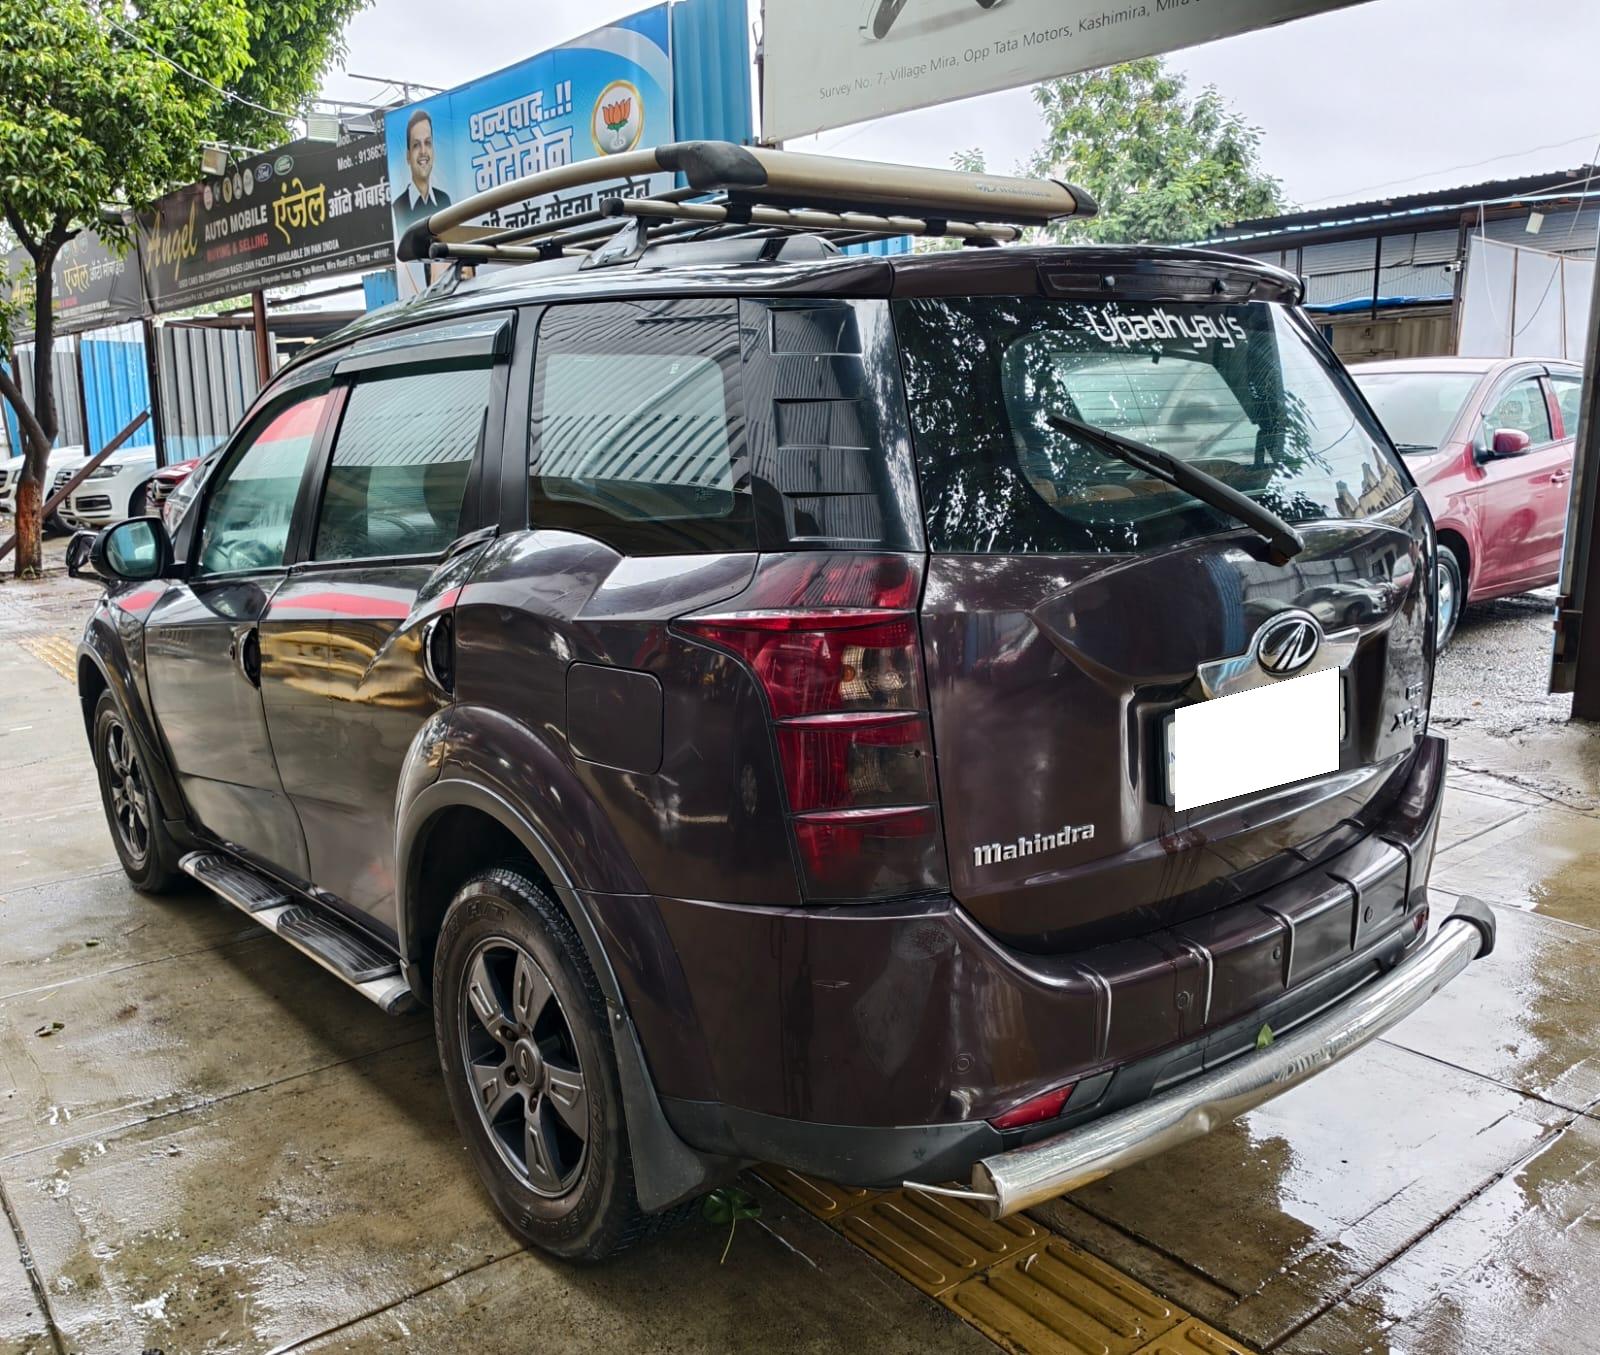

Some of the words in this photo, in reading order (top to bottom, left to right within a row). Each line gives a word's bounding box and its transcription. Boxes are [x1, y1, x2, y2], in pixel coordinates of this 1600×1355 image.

[819, 82, 851, 99] Survey
[854, 77, 872, 90] No.
[889, 62, 927, 80] Village
[930, 55, 960, 72] Mira,
[963, 47, 990, 64] Opp
[994, 38, 1018, 54] Tata
[1023, 25, 1073, 48] Motors,
[1078, 6, 1150, 33] Kashimira,
[204, 217, 229, 242] AUTO
[230, 204, 268, 233] MOBILE
[272, 177, 326, 245] एंजेल
[328, 188, 352, 218] ऑटो
[146, 199, 198, 281] Angel
[239, 233, 269, 253] SELLING
[1084, 306, 1247, 348] Upadhyay's
[974, 824, 1095, 867] Mahindra
